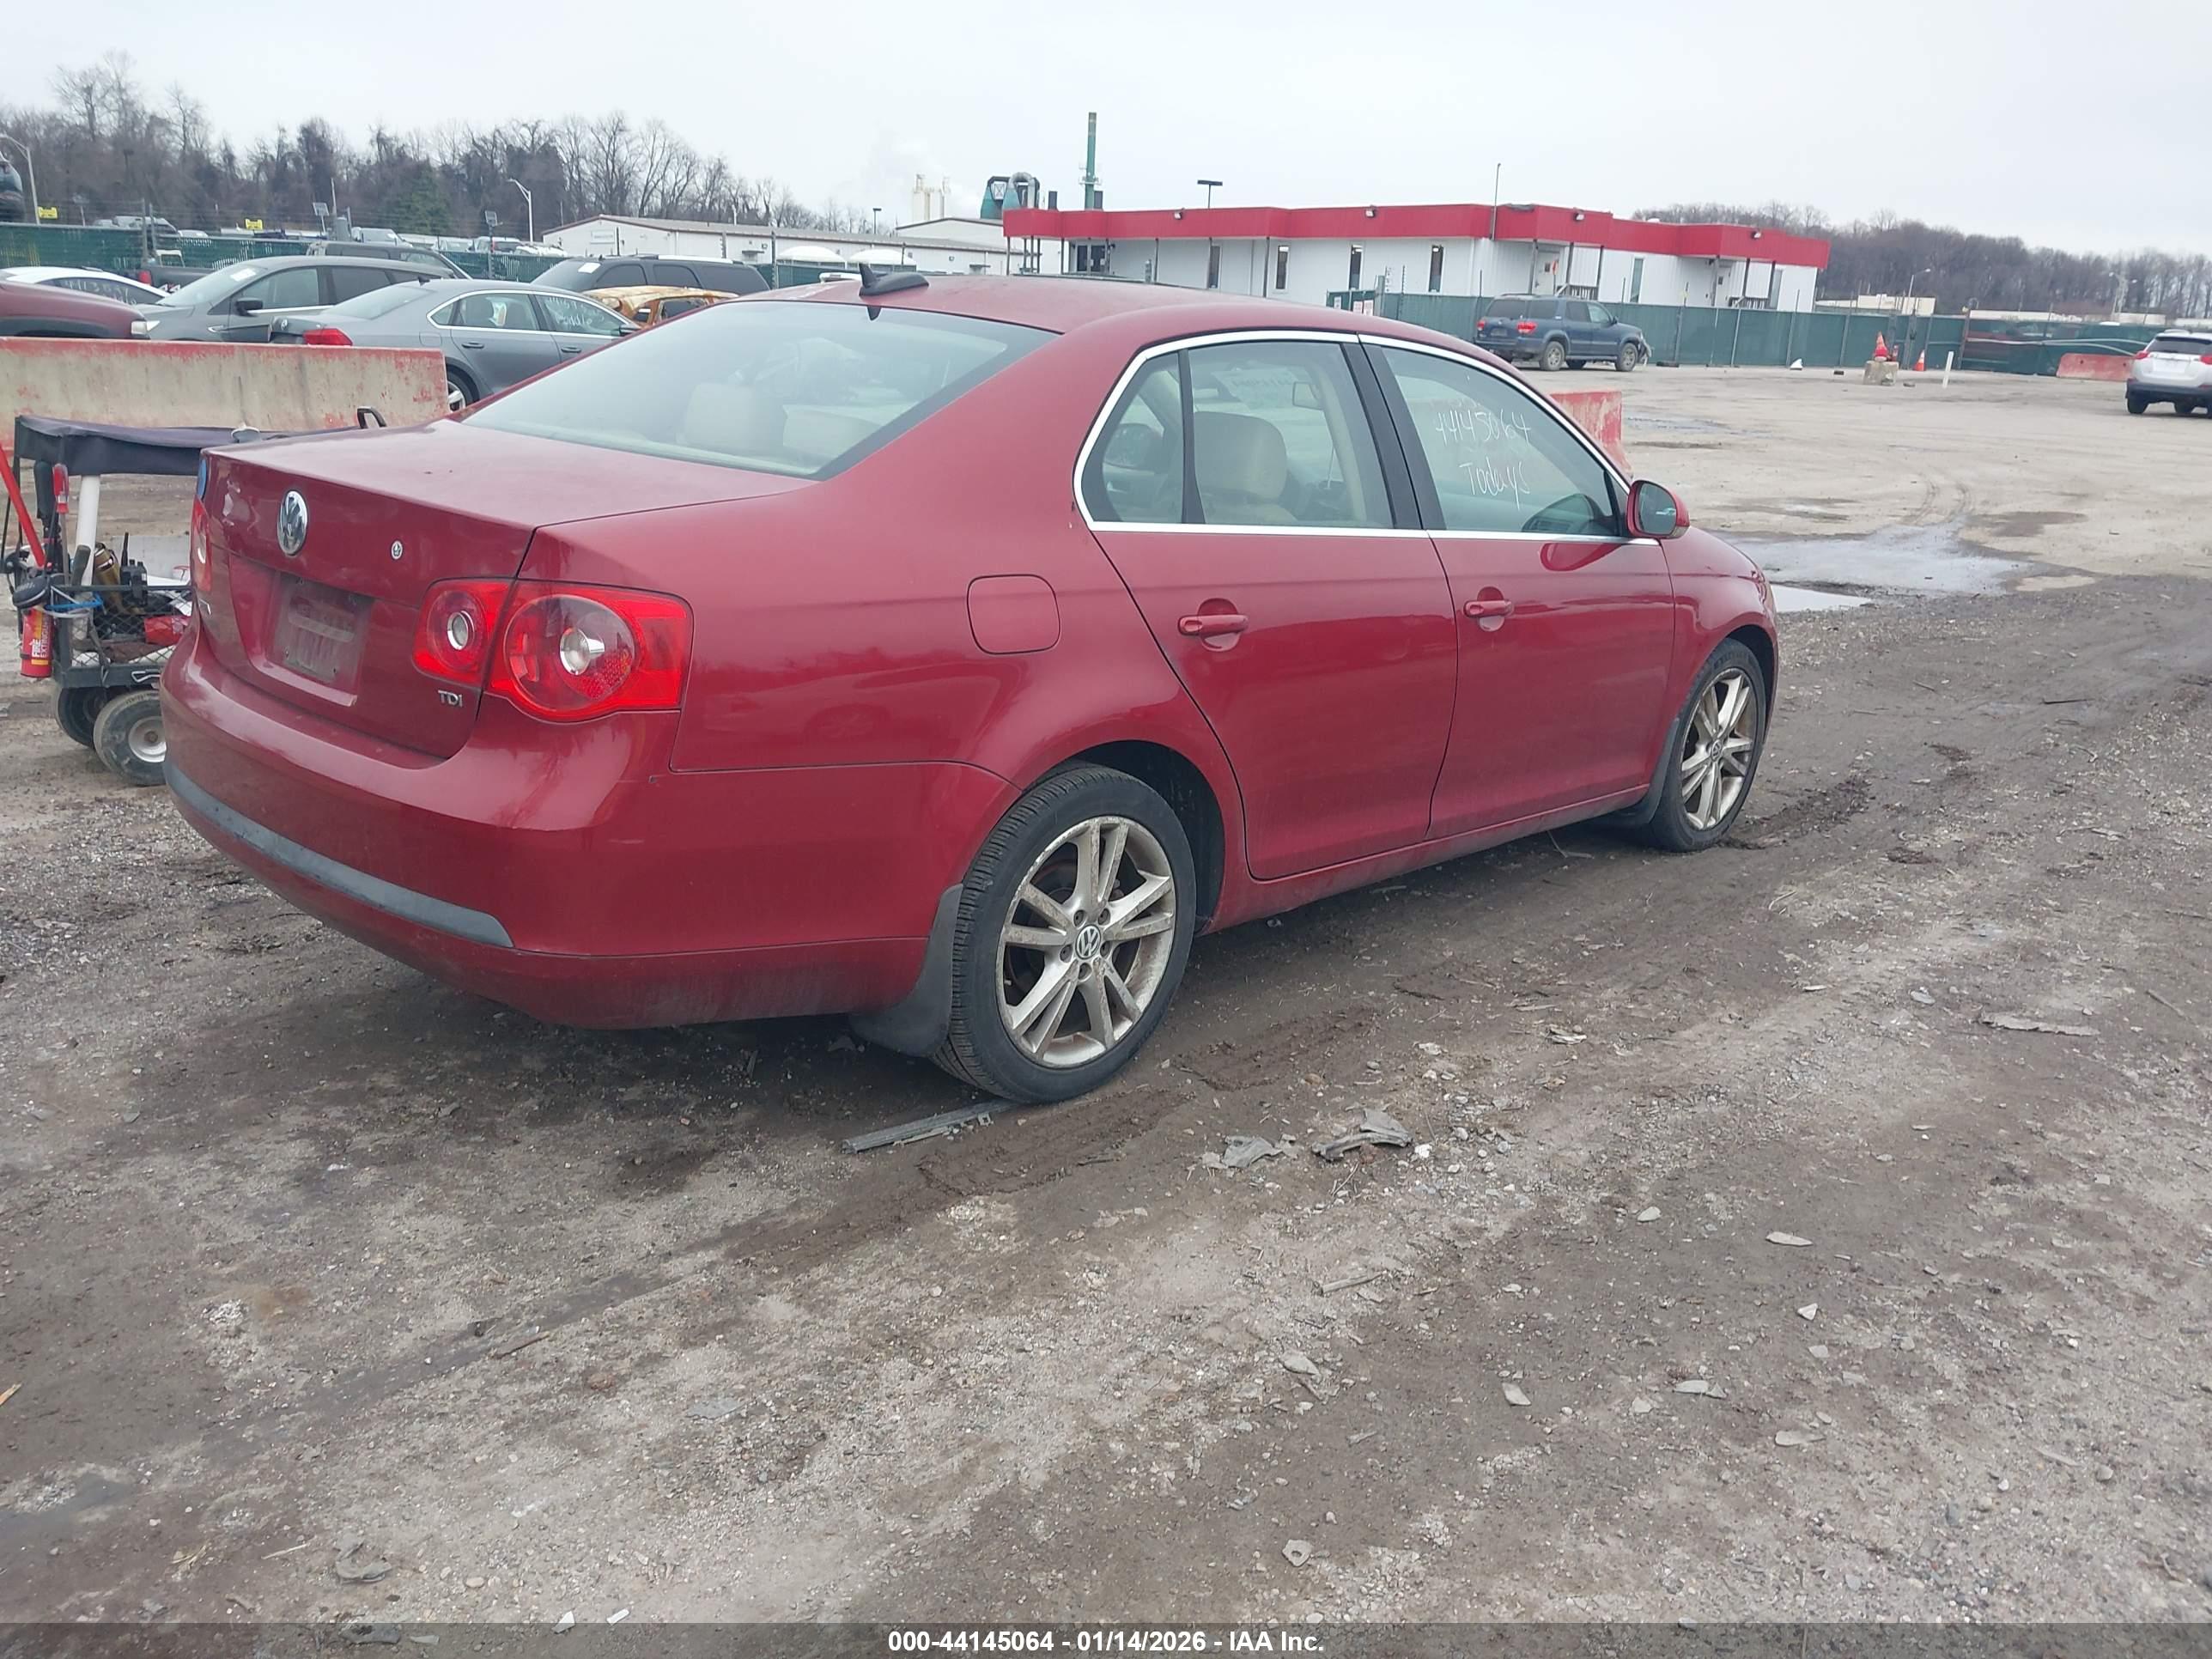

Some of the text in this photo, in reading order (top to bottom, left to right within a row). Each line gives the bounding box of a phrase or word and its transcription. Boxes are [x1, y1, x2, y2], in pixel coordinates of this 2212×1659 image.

[1435, 409, 1531, 447] 44145064
[32, 639, 41, 658] FIRE
[1076, 924, 1102, 959] VW
